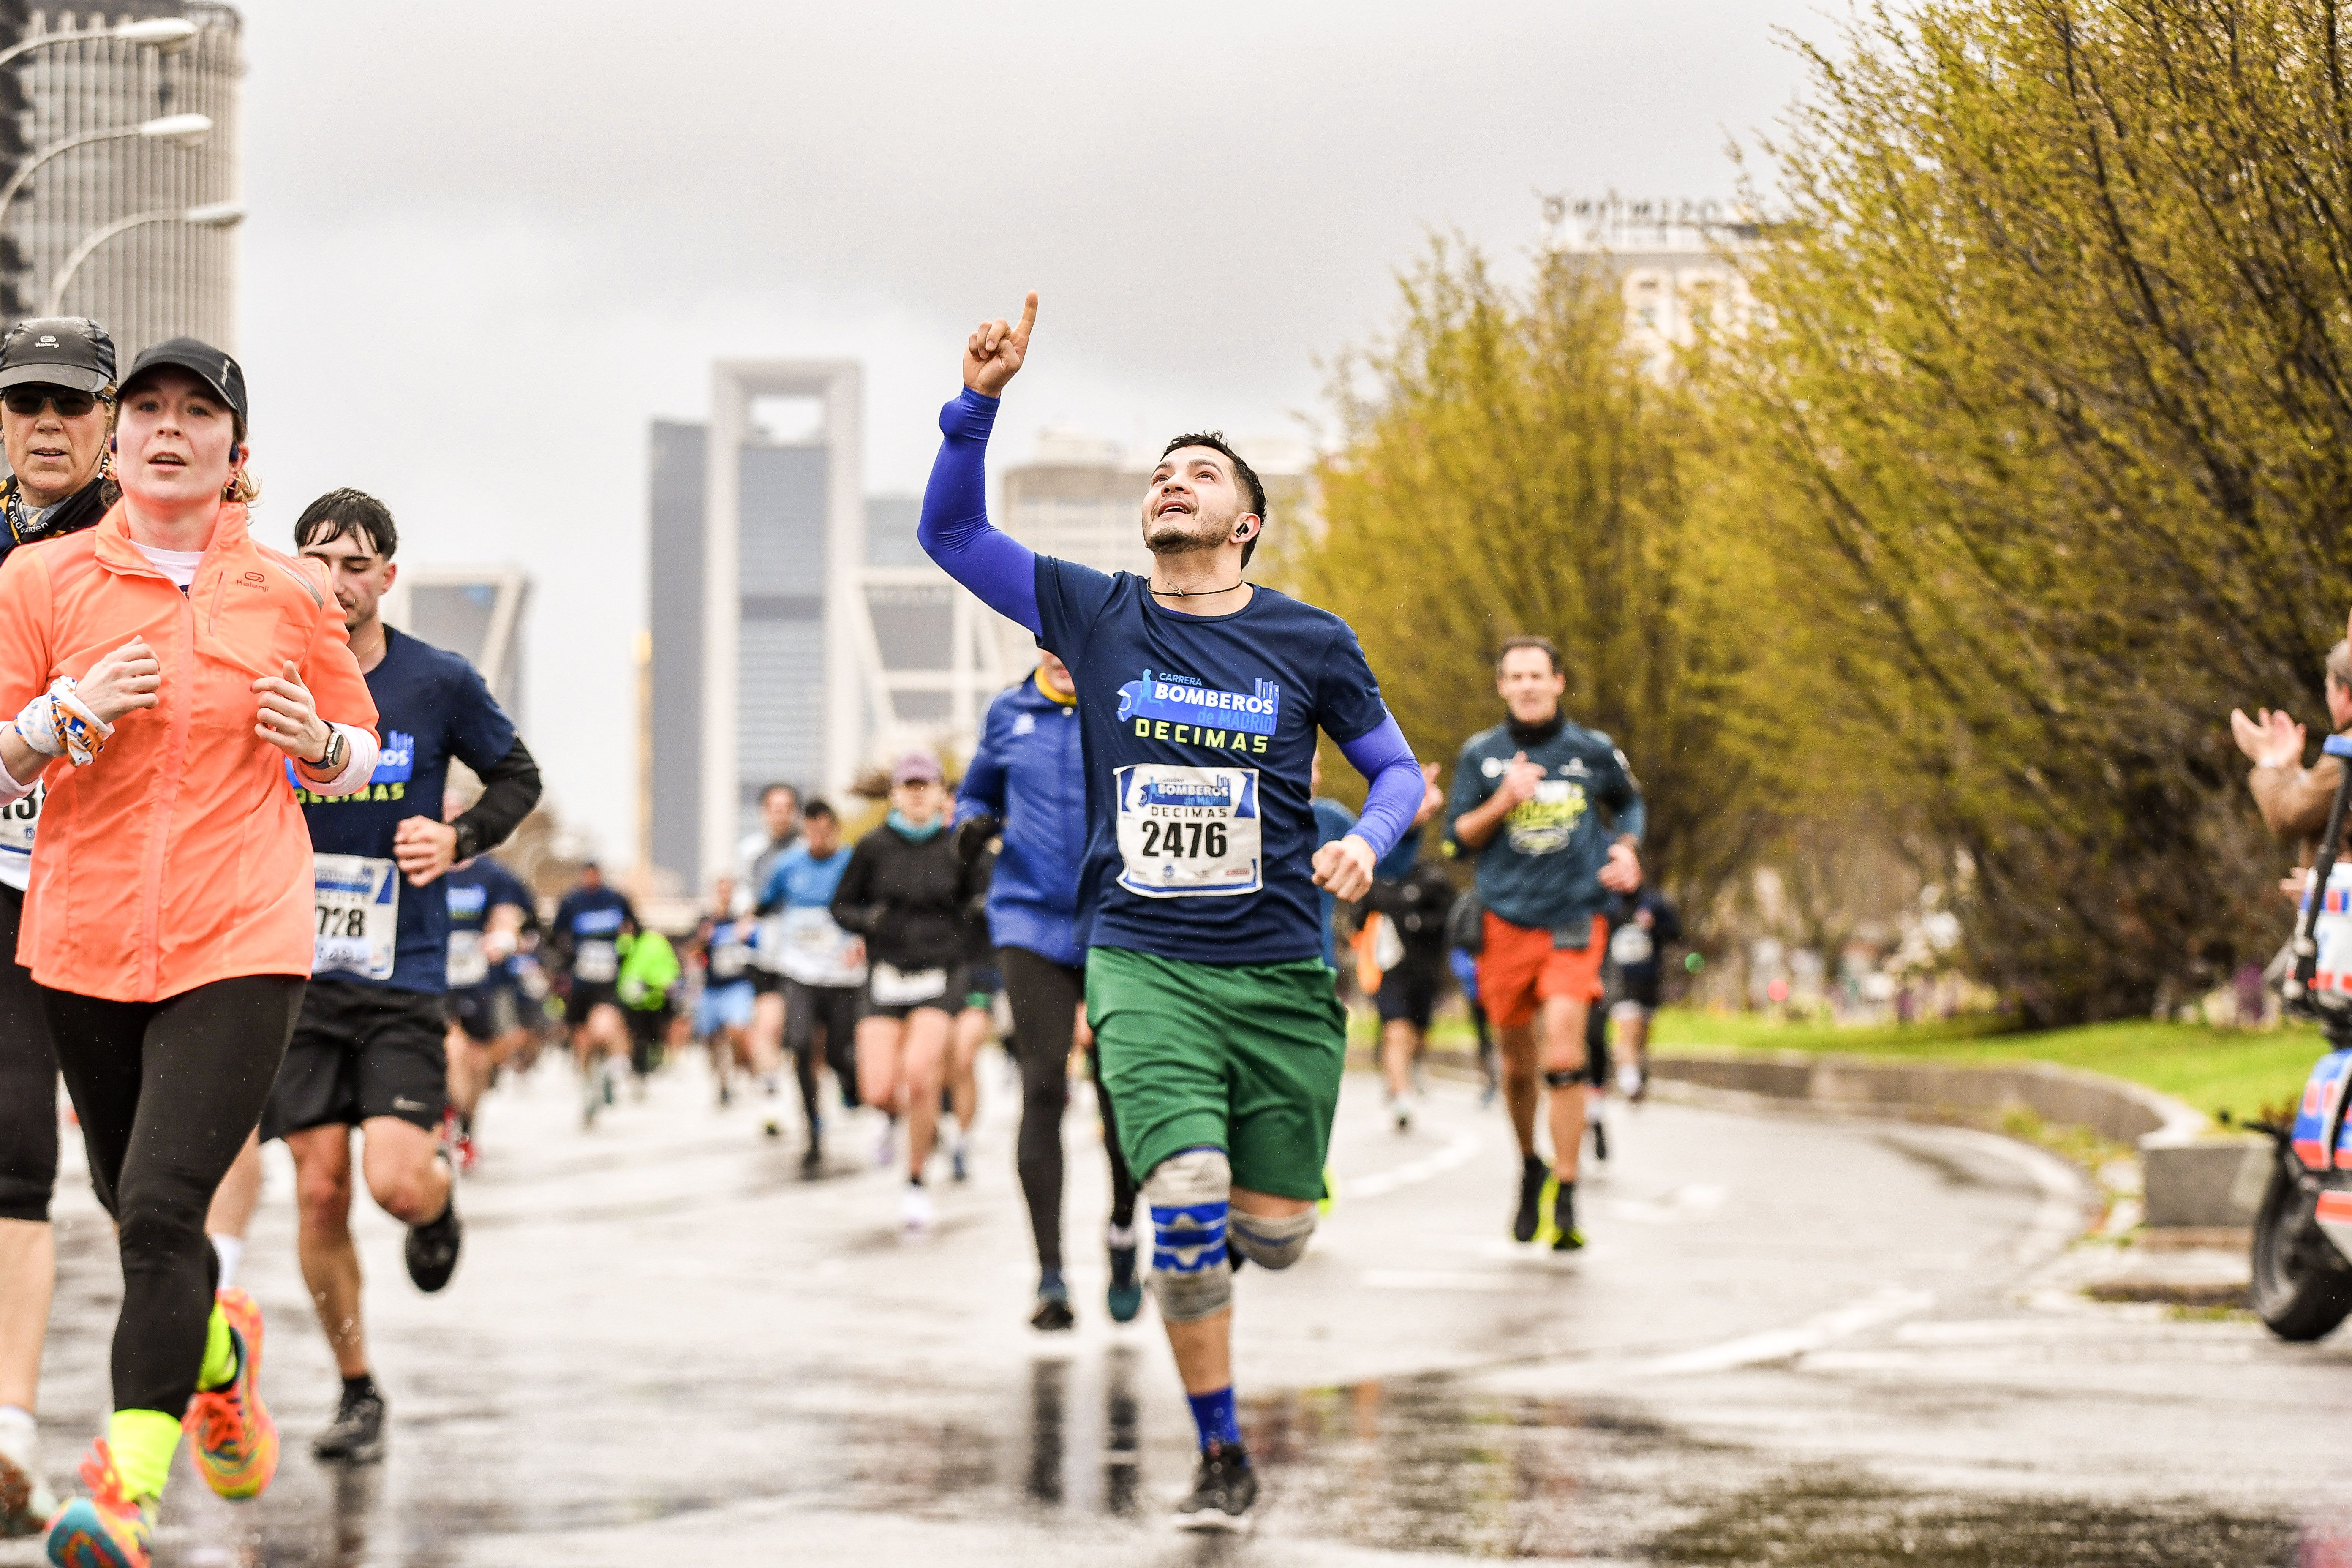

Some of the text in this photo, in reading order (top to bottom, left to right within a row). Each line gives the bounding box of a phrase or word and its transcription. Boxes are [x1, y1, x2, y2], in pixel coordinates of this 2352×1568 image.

[236, 579, 269, 593] Kalenji
[1159, 672, 1202, 686] CARRERA
[1154, 683, 1274, 715] BOMBEROS
[1198, 708, 1273, 733] de MADRID
[1135, 718, 1269, 754] DECIMAS
[1158, 784, 1229, 797] BOMBEROS
[1152, 806, 1227, 818] DECIMAS
[1142, 820, 1227, 858] 2476
[315, 906, 364, 937] 728
